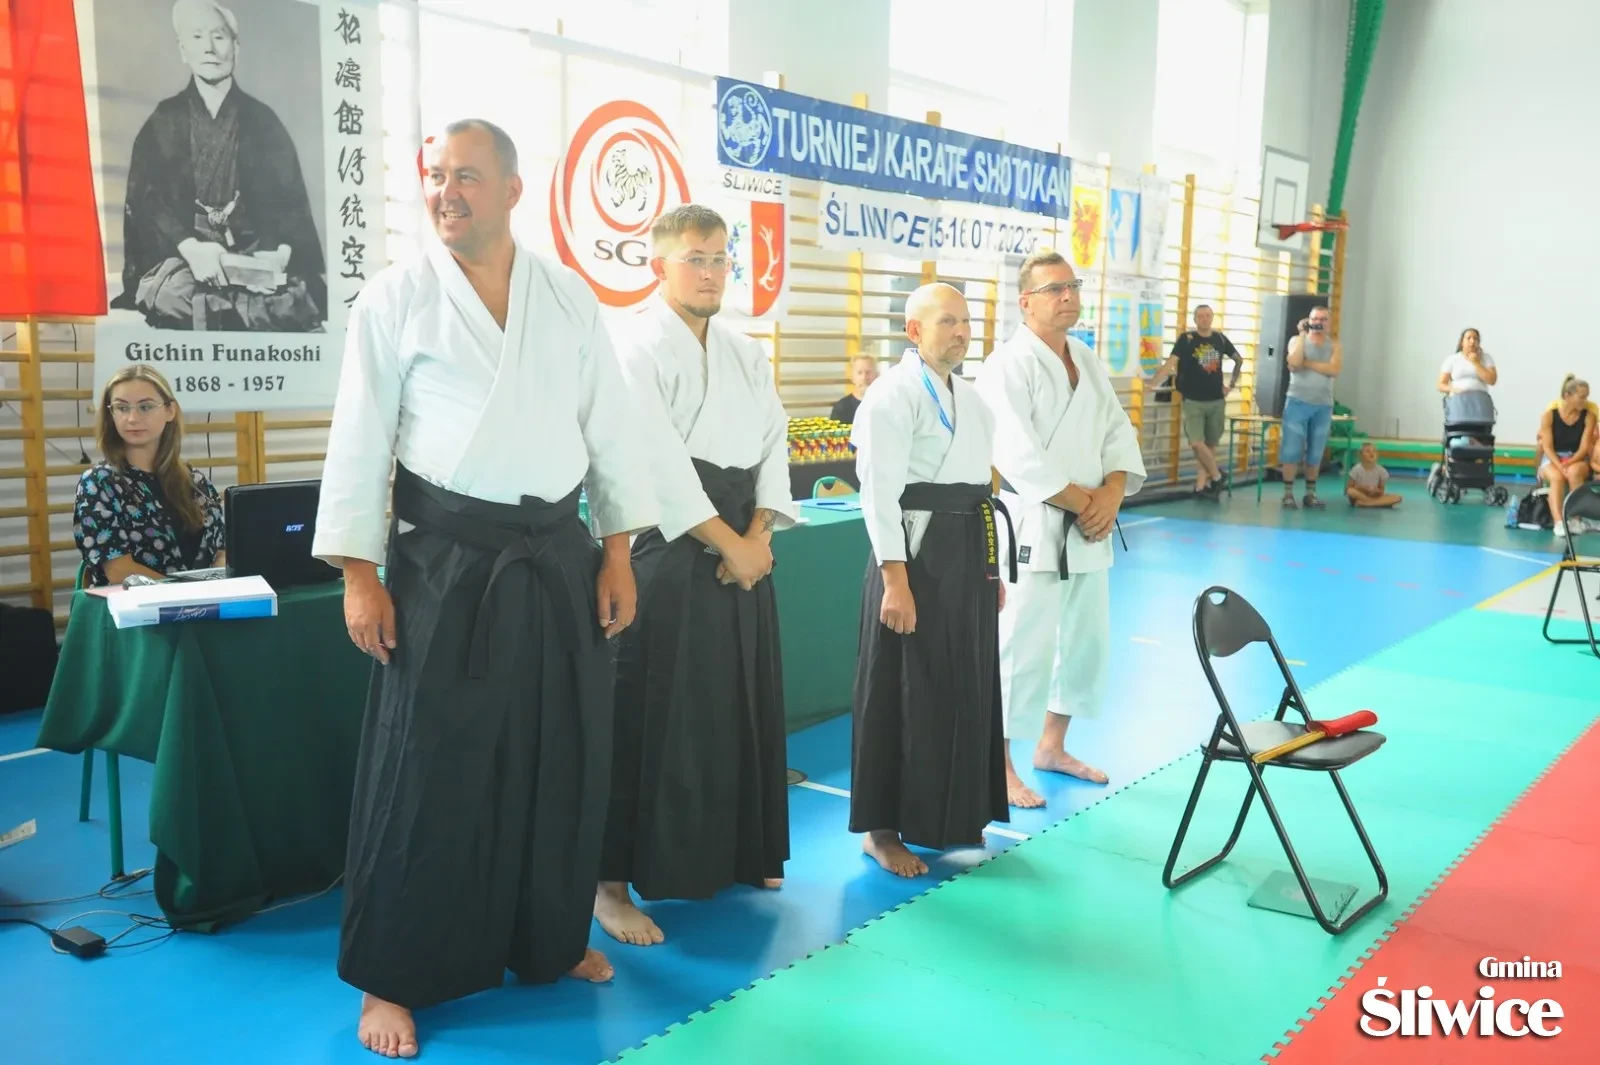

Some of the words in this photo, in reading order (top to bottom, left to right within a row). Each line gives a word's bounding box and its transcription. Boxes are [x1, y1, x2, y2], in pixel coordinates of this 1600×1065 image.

[772, 107, 880, 177] TURNIEJ
[883, 132, 969, 190] KARATE
[973, 150, 1070, 211] SHOTOKAN
[723, 169, 783, 197] ŚLIWICE
[825, 191, 929, 248] ŚLIWCE
[125, 341, 204, 363] Gichin
[212, 343, 321, 363] Funakoshi
[174, 376, 221, 393] 1868
[243, 375, 285, 392] 1957
